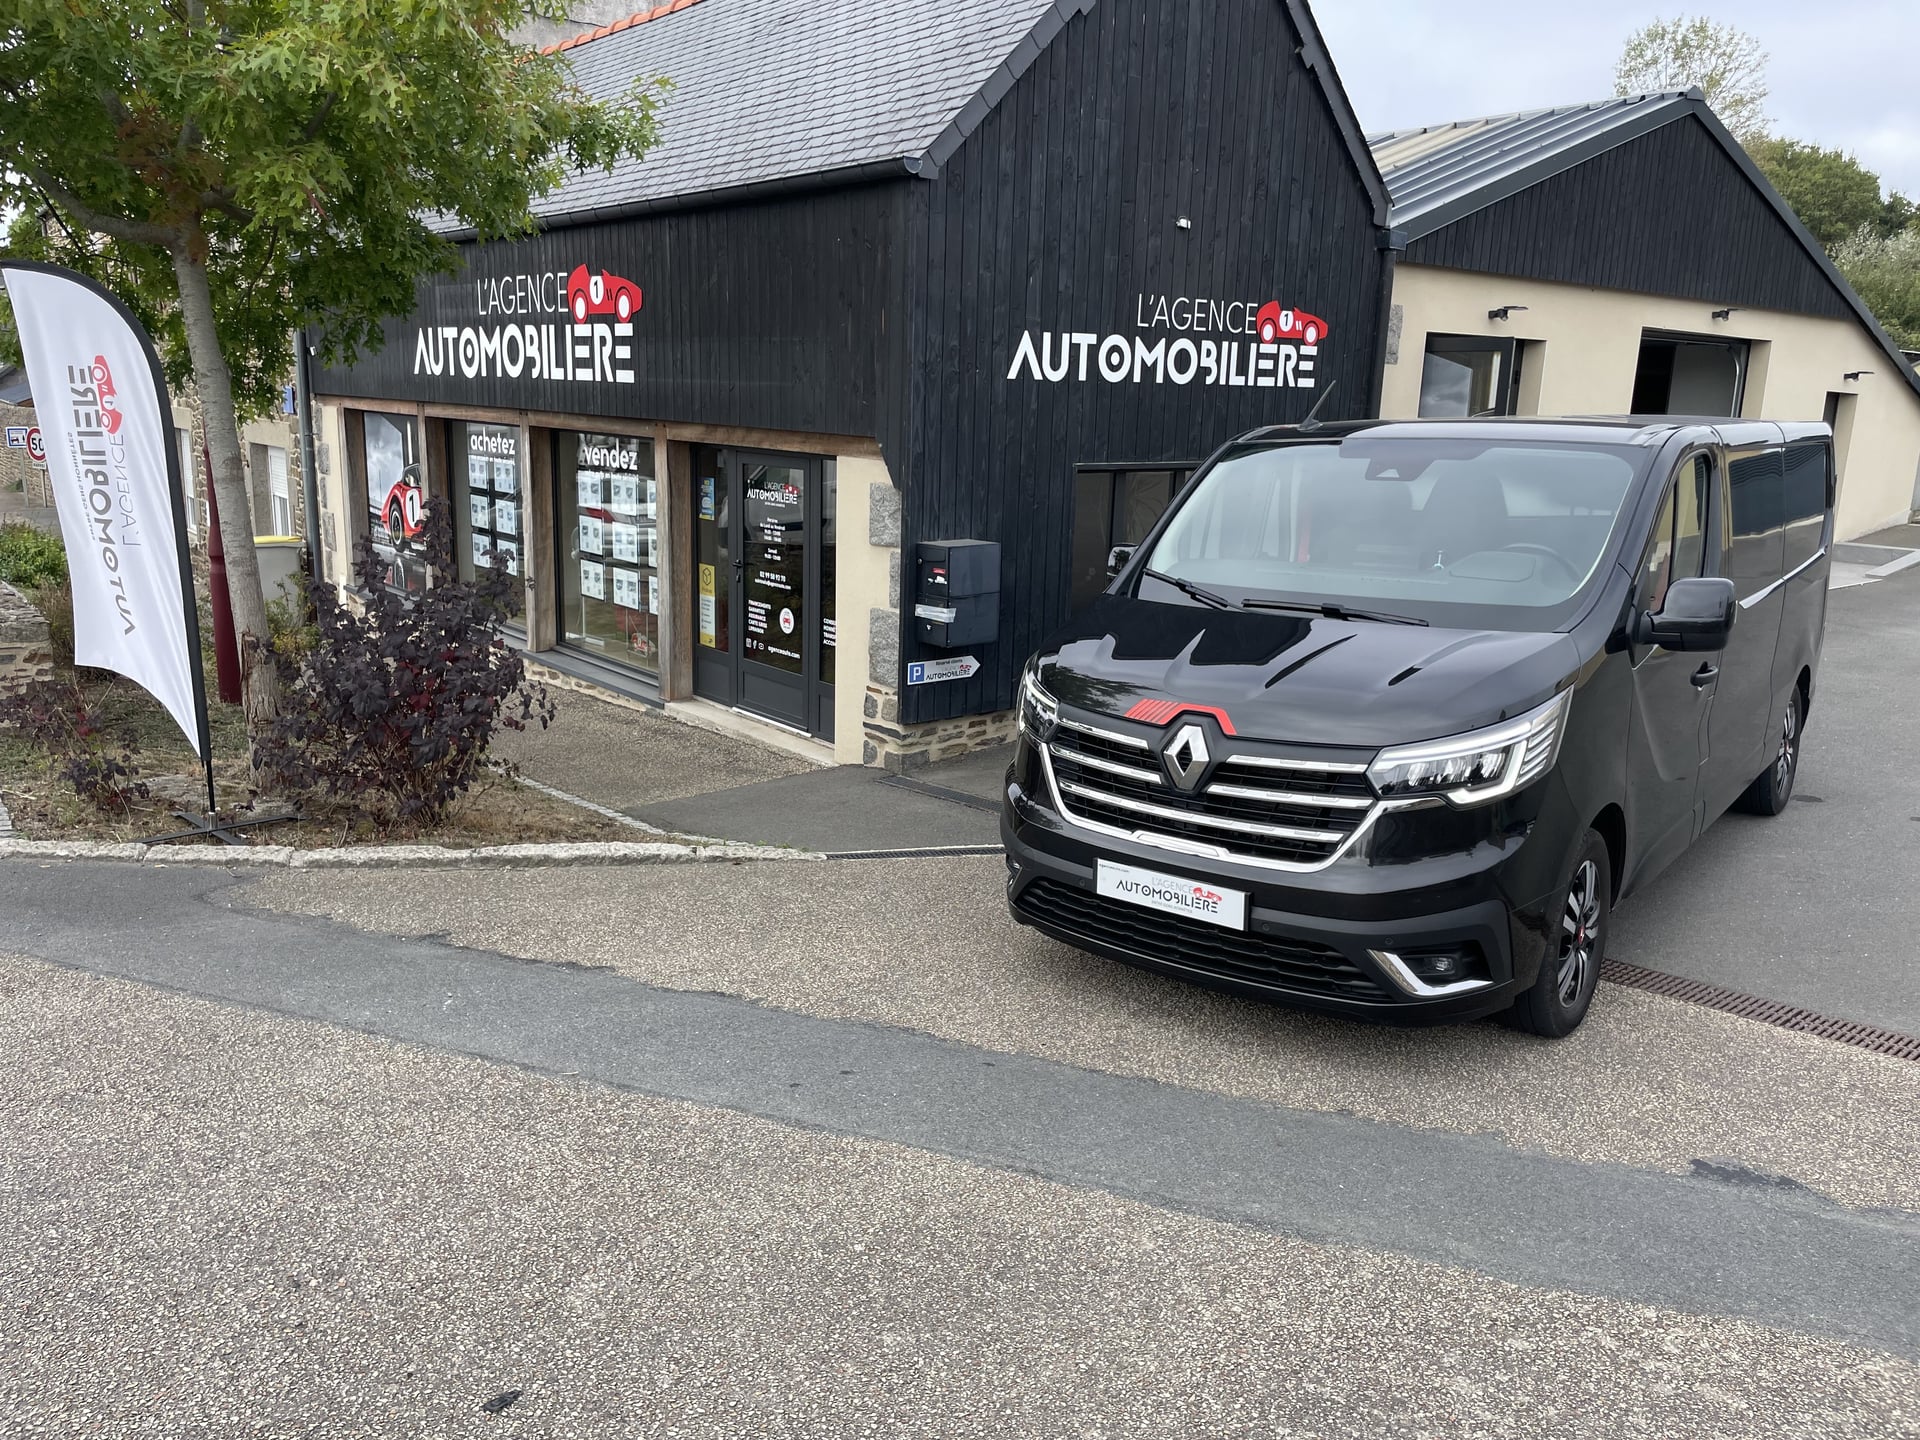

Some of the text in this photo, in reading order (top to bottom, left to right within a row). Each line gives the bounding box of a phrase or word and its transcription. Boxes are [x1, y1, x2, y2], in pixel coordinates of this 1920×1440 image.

[478, 272, 569, 315] L'AGENCE
[1136, 293, 1259, 334] L'AGENCE
[414, 323, 635, 383] AUTOMOBILIERE
[1007, 329, 1318, 388] AUTOMOBILIERE
[471, 426, 516, 455] achetez
[583, 437, 638, 471] vendez
[746, 487, 798, 505] AUTOMOBILIERE
[914, 667, 921, 680] P
[1116, 879, 1219, 914] AUTOMOBILIERE
[1151, 876, 1194, 895] L'AGENCE
